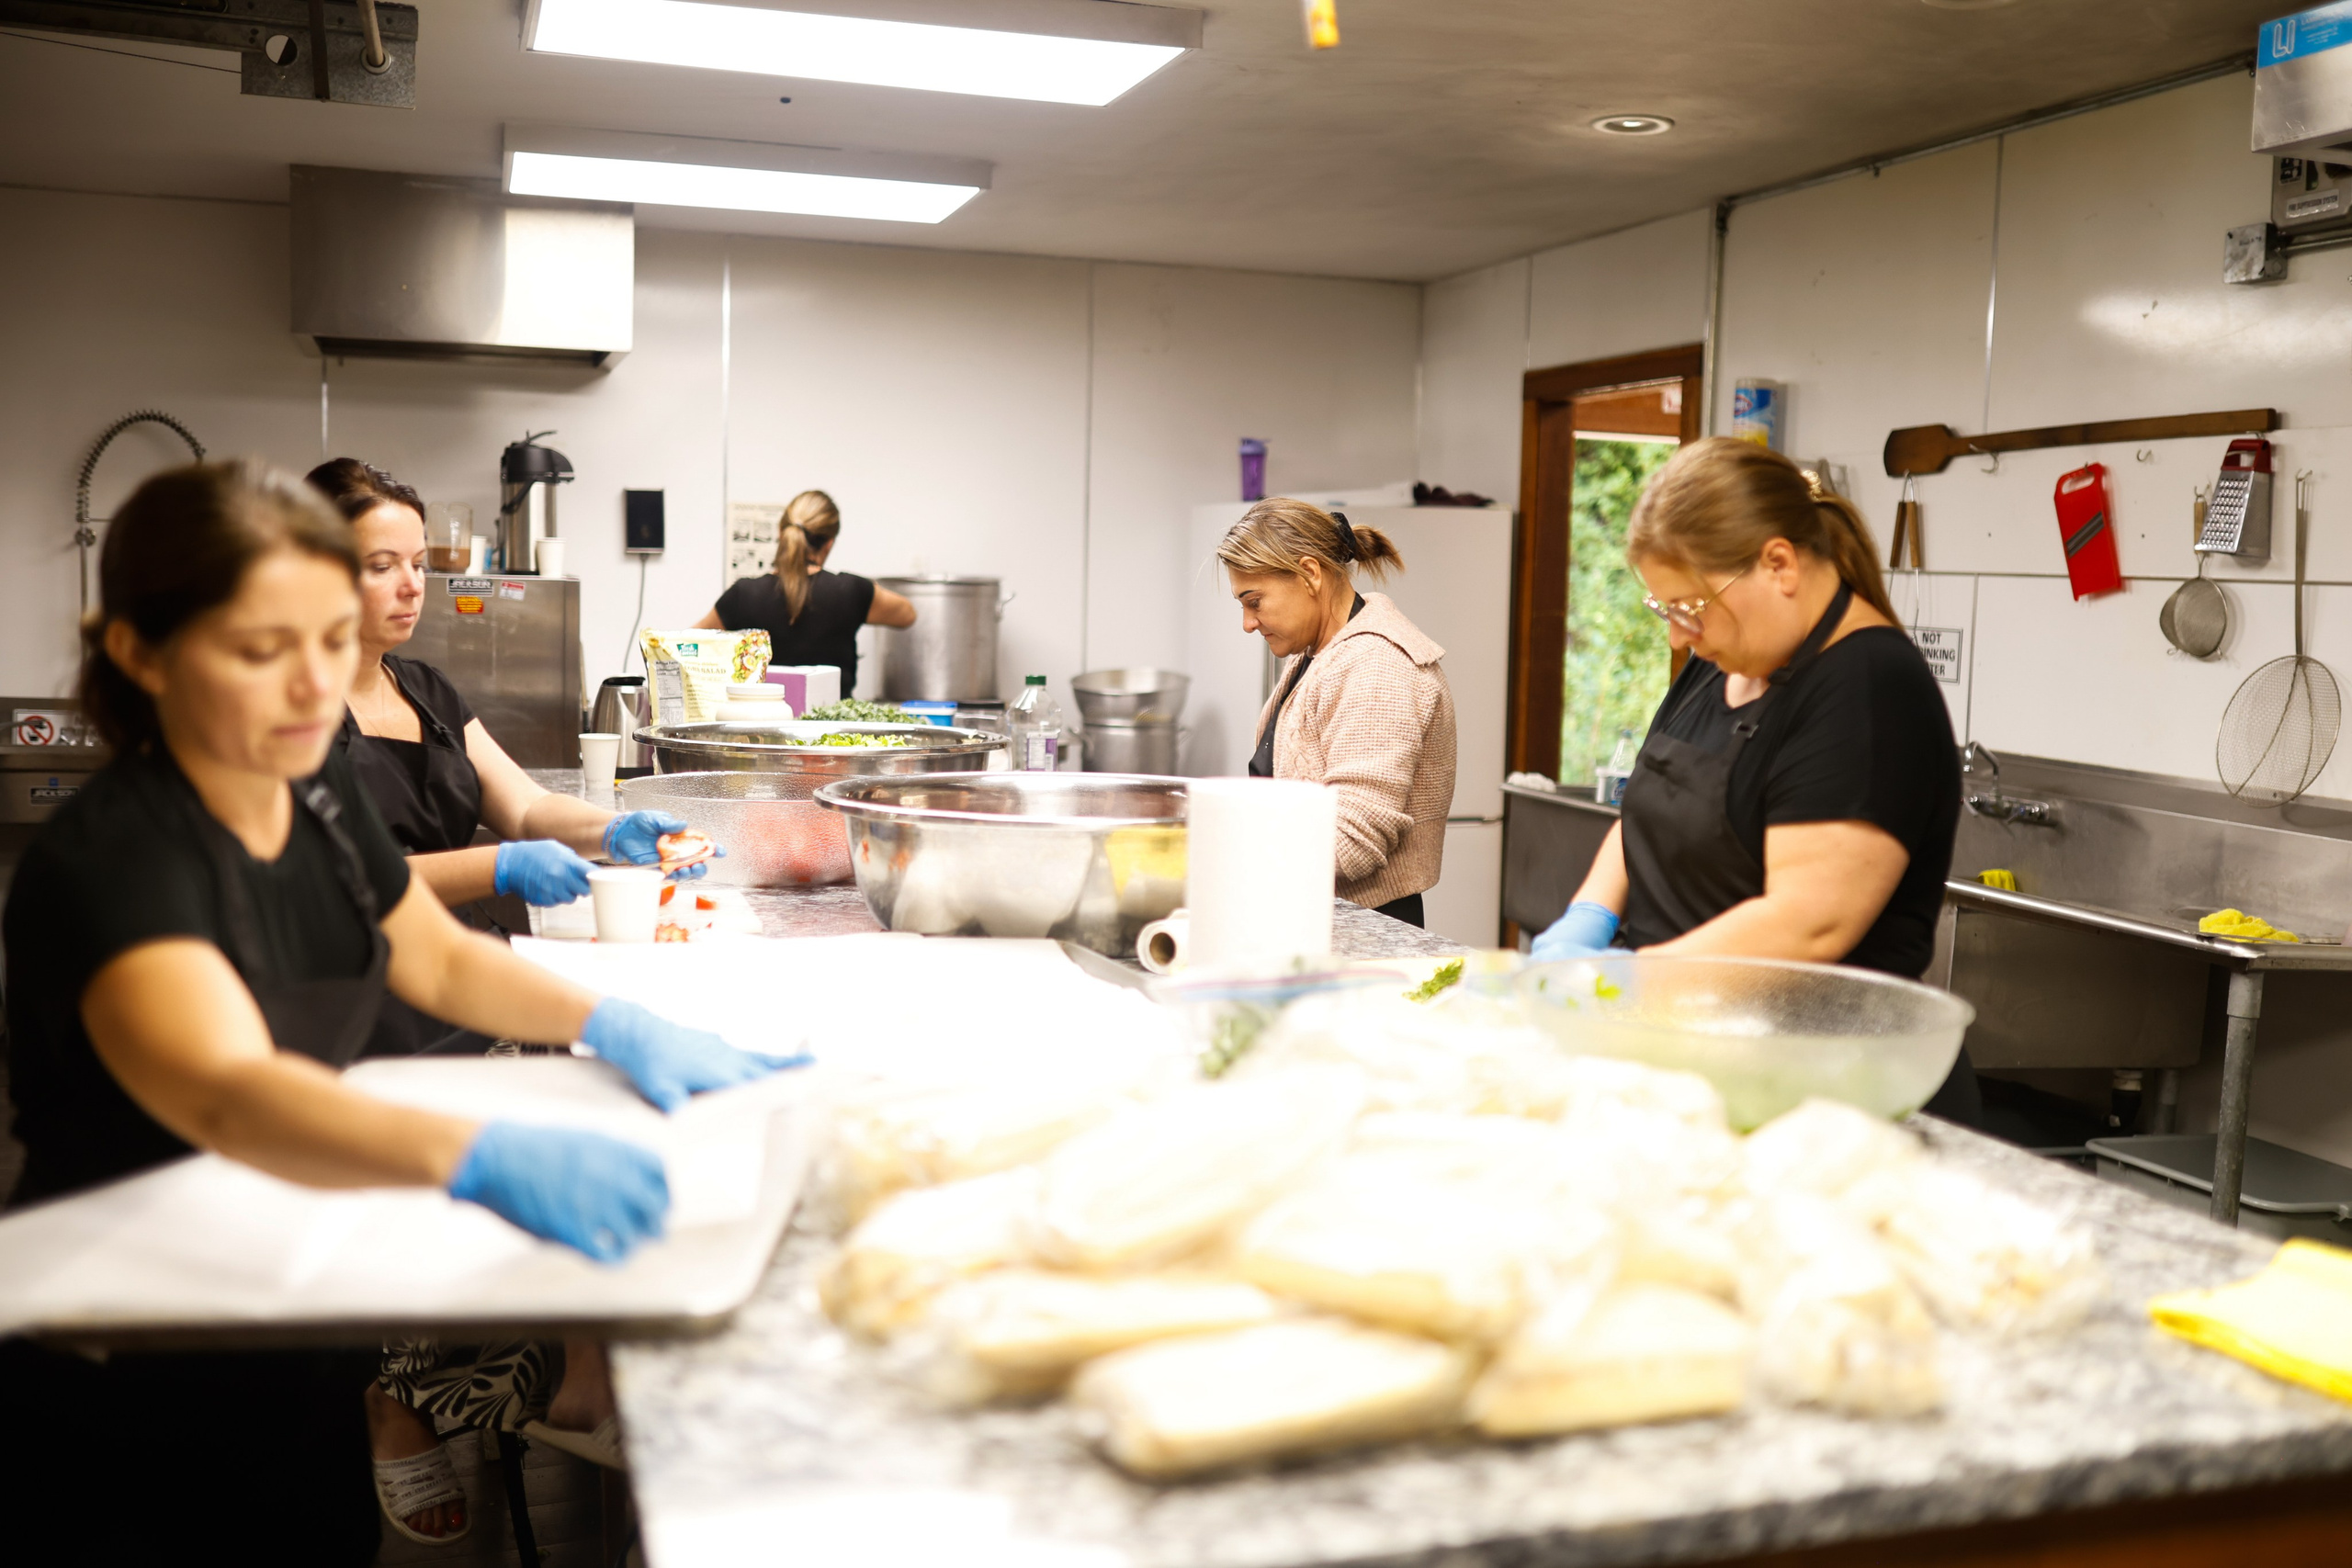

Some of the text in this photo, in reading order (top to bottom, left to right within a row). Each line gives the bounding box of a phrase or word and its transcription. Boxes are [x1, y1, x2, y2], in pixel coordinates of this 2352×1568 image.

[2297, 198, 2323, 209] SUPPRESSION
[2323, 195, 2338, 205] SYSTEM
[449, 580, 492, 589] JACKSON
[1922, 632, 1941, 645] NOT
[1929, 662, 1946, 677] TER
